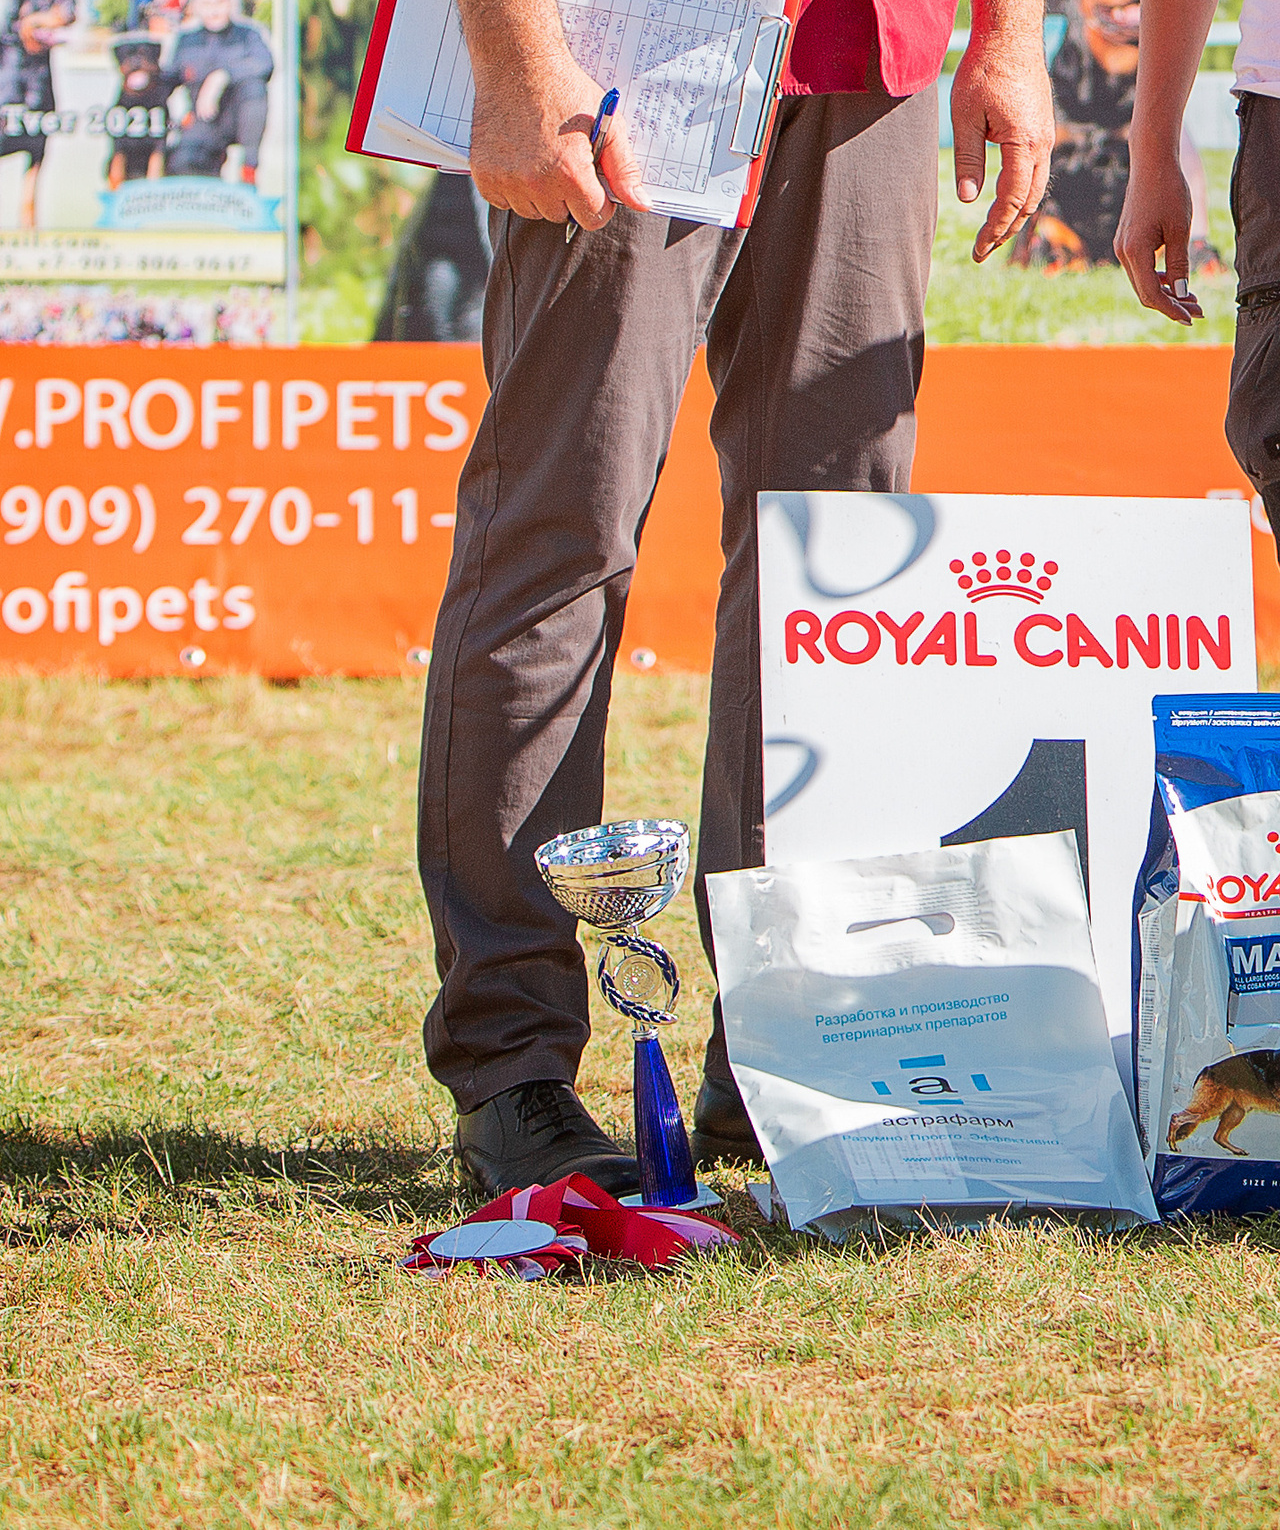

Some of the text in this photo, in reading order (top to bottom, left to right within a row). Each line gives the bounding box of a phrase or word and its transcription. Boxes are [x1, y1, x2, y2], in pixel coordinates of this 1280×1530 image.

[87, 104, 167, 138] 2021
[0, 378, 470, 451] .PROFIPETS
[0, 570, 256, 646] ofipets
[784, 610, 1232, 670] ROYAL CANIN
[815, 993, 1010, 1027] Разработка и производство
[822, 1010, 1008, 1044] ветеринарных препаратов
[882, 1113, 1015, 1129] астрафарм
[1242, 1178, 1265, 1187] SIZE
